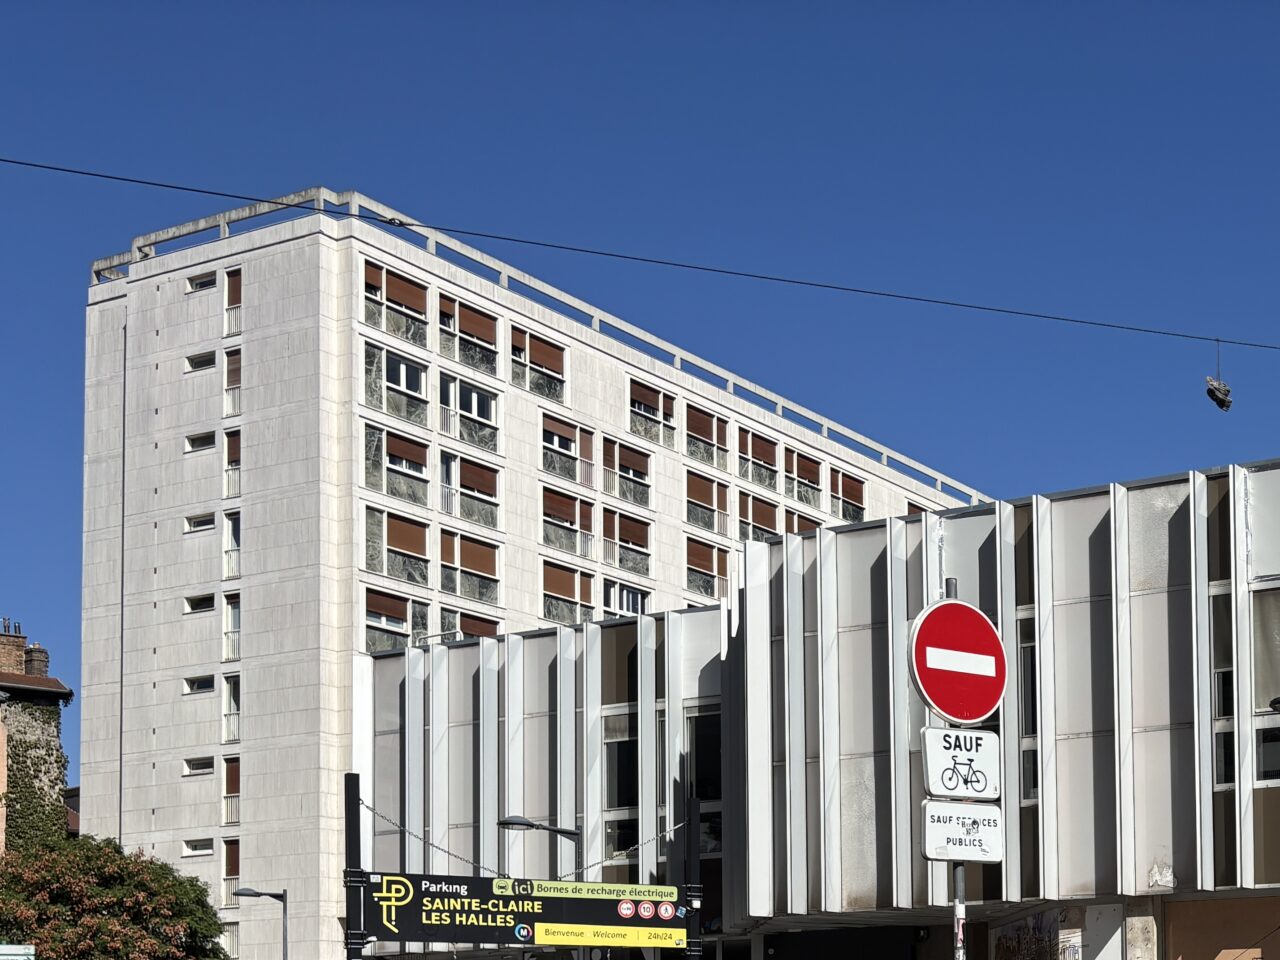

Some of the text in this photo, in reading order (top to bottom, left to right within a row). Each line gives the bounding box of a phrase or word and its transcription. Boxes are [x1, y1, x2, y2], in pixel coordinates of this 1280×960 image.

[943, 734, 983, 752] SAUF
[930, 815, 953, 824] SAUF
[946, 837, 983, 847] PUBLICS
[421, 880, 468, 896] Parking
[514, 881, 675, 898] ici Bornes de recharge électrique
[422, 897, 543, 912] SAINTE-CLAIRE
[421, 911, 515, 926] LES HALLES
[544, 928, 673, 940] Bienvenue Welcome 24h/24
